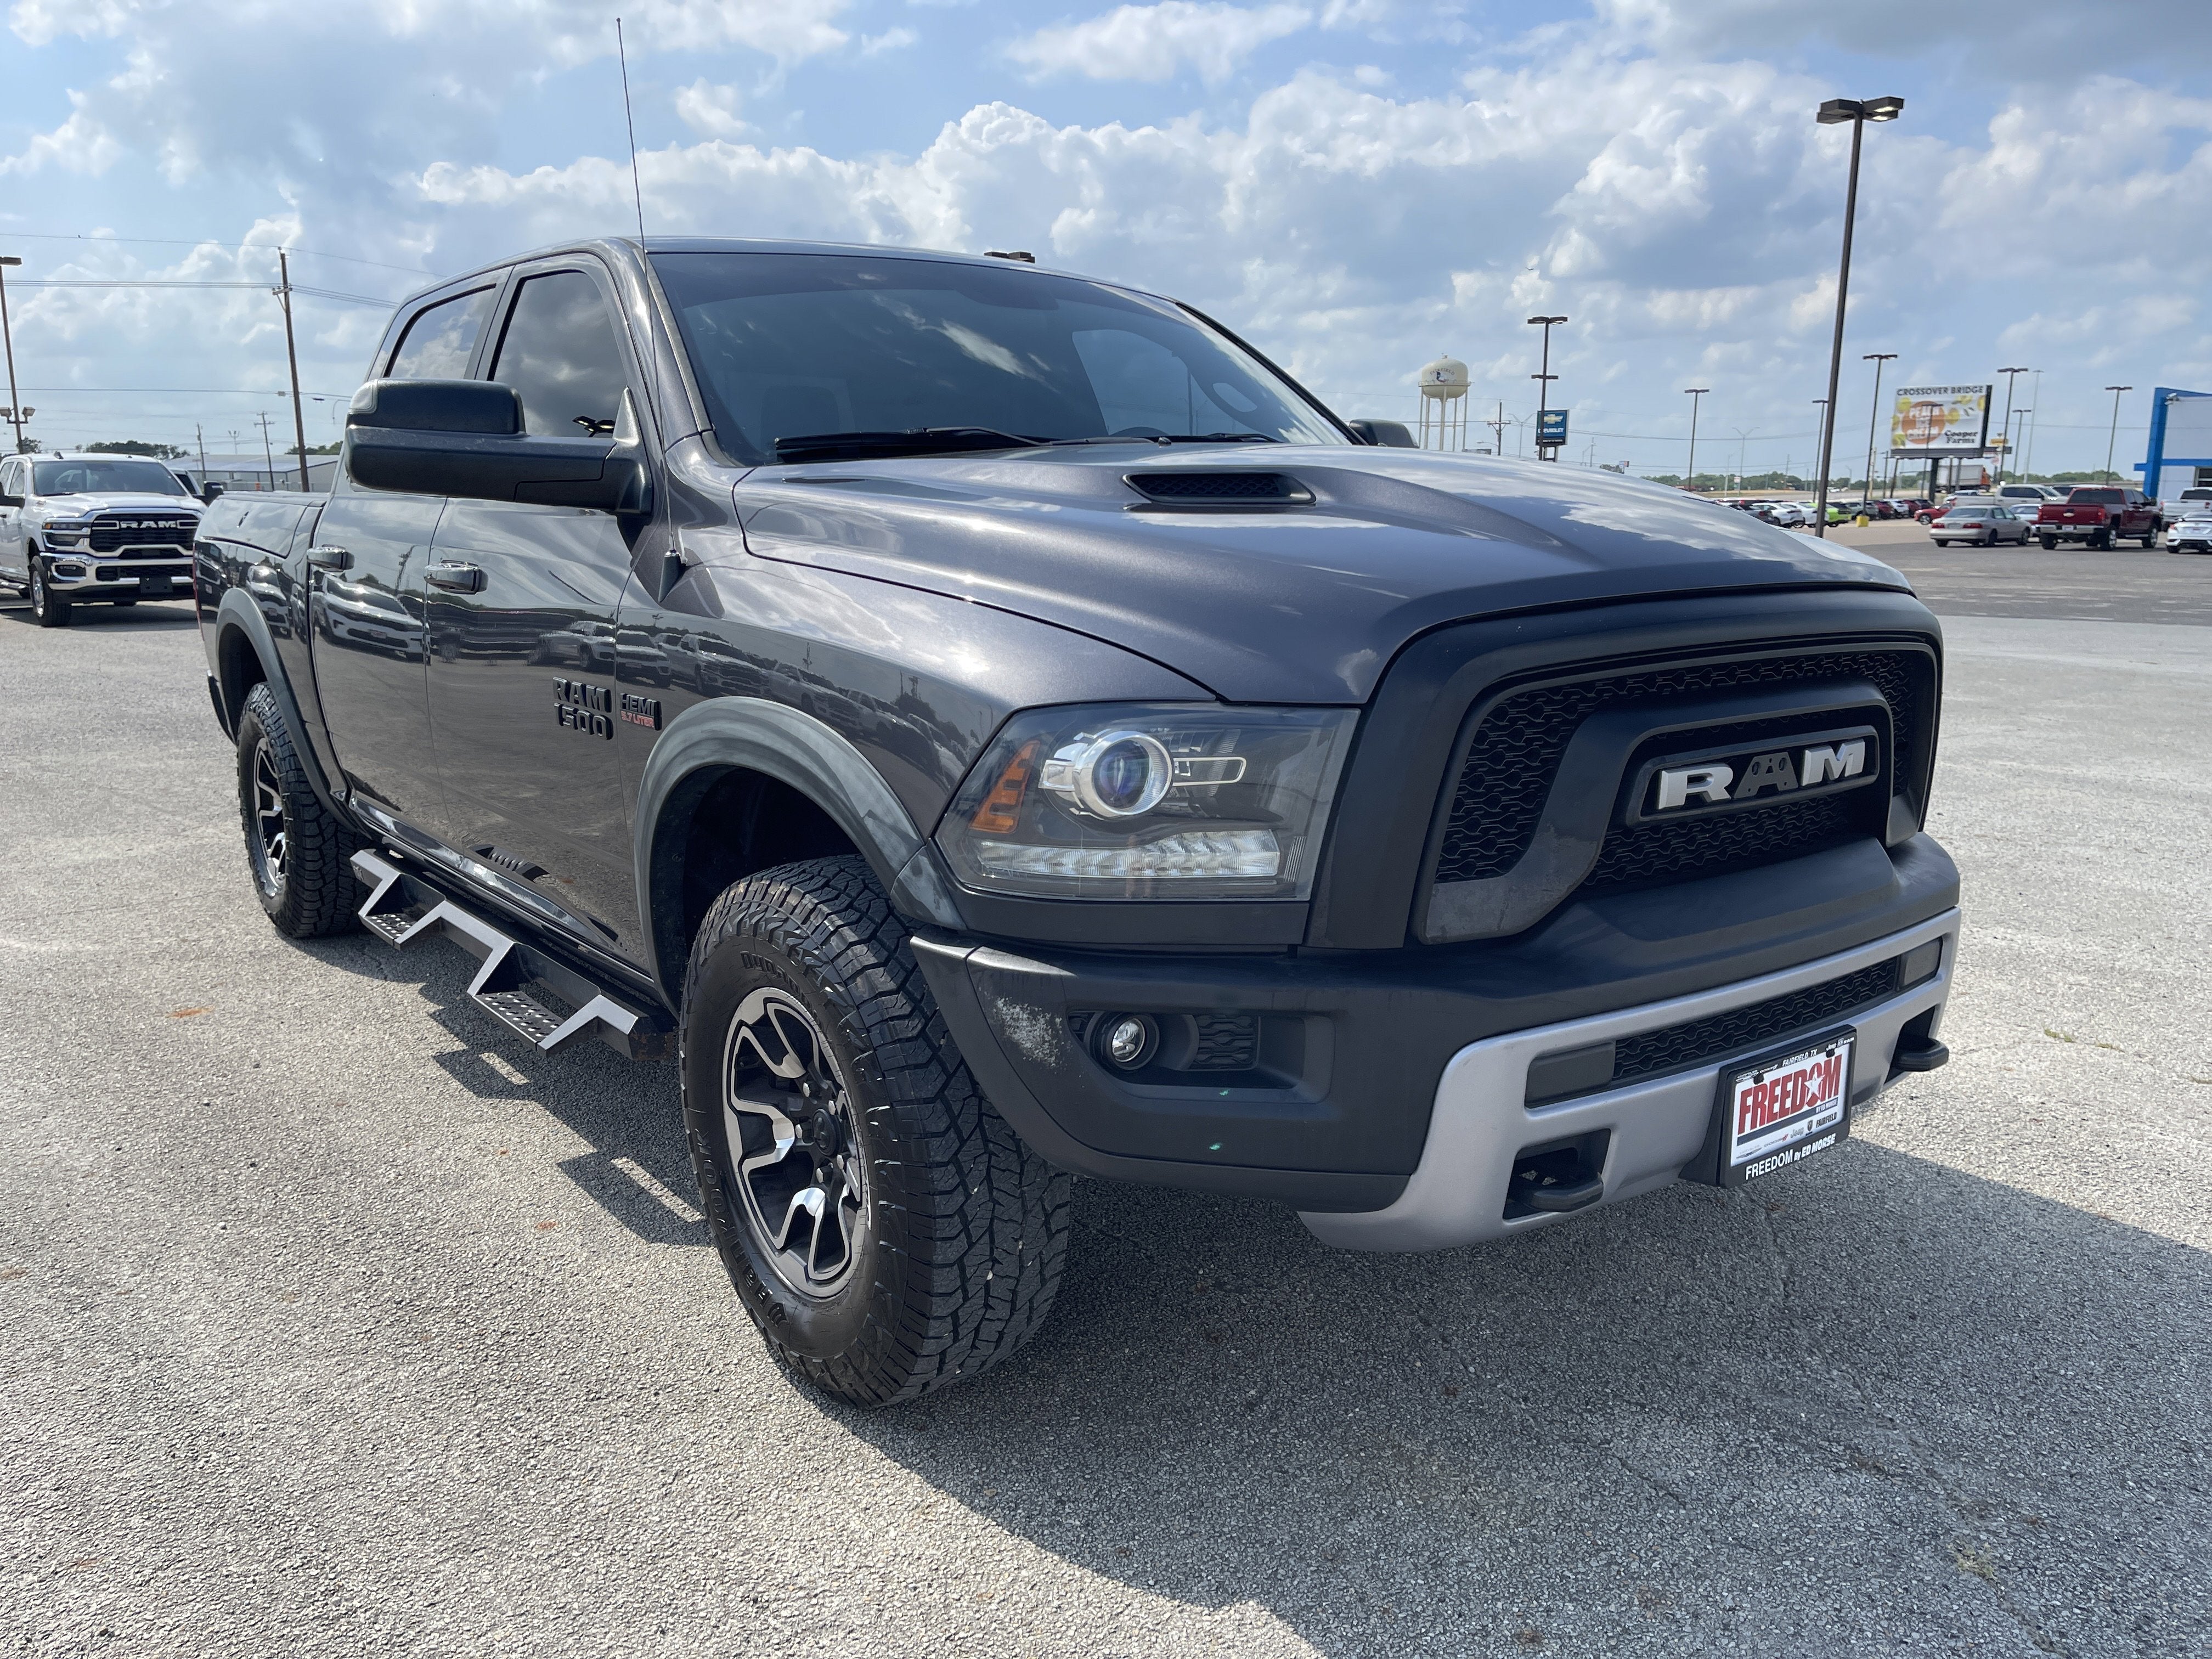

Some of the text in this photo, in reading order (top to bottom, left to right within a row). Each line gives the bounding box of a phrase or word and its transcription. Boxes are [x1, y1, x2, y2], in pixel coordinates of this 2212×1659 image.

[1897, 386, 1983, 396] CROSSOVER BRIDGE
[119, 520, 177, 528] RAM
[552, 676, 612, 713] RAM
[620, 693, 659, 716] HEMI
[554, 702, 614, 741] 1500
[620, 710, 654, 728] 5.7 LITER
[1657, 737, 1866, 810] RAM
[1810, 1048, 1818, 1057] TX
[1737, 1053, 1843, 1135] FREEDOM
[1746, 1148, 1793, 1180] FREEDOM
[1801, 1144, 1812, 1158] ED
[1811, 1133, 1836, 1154] MORSE
